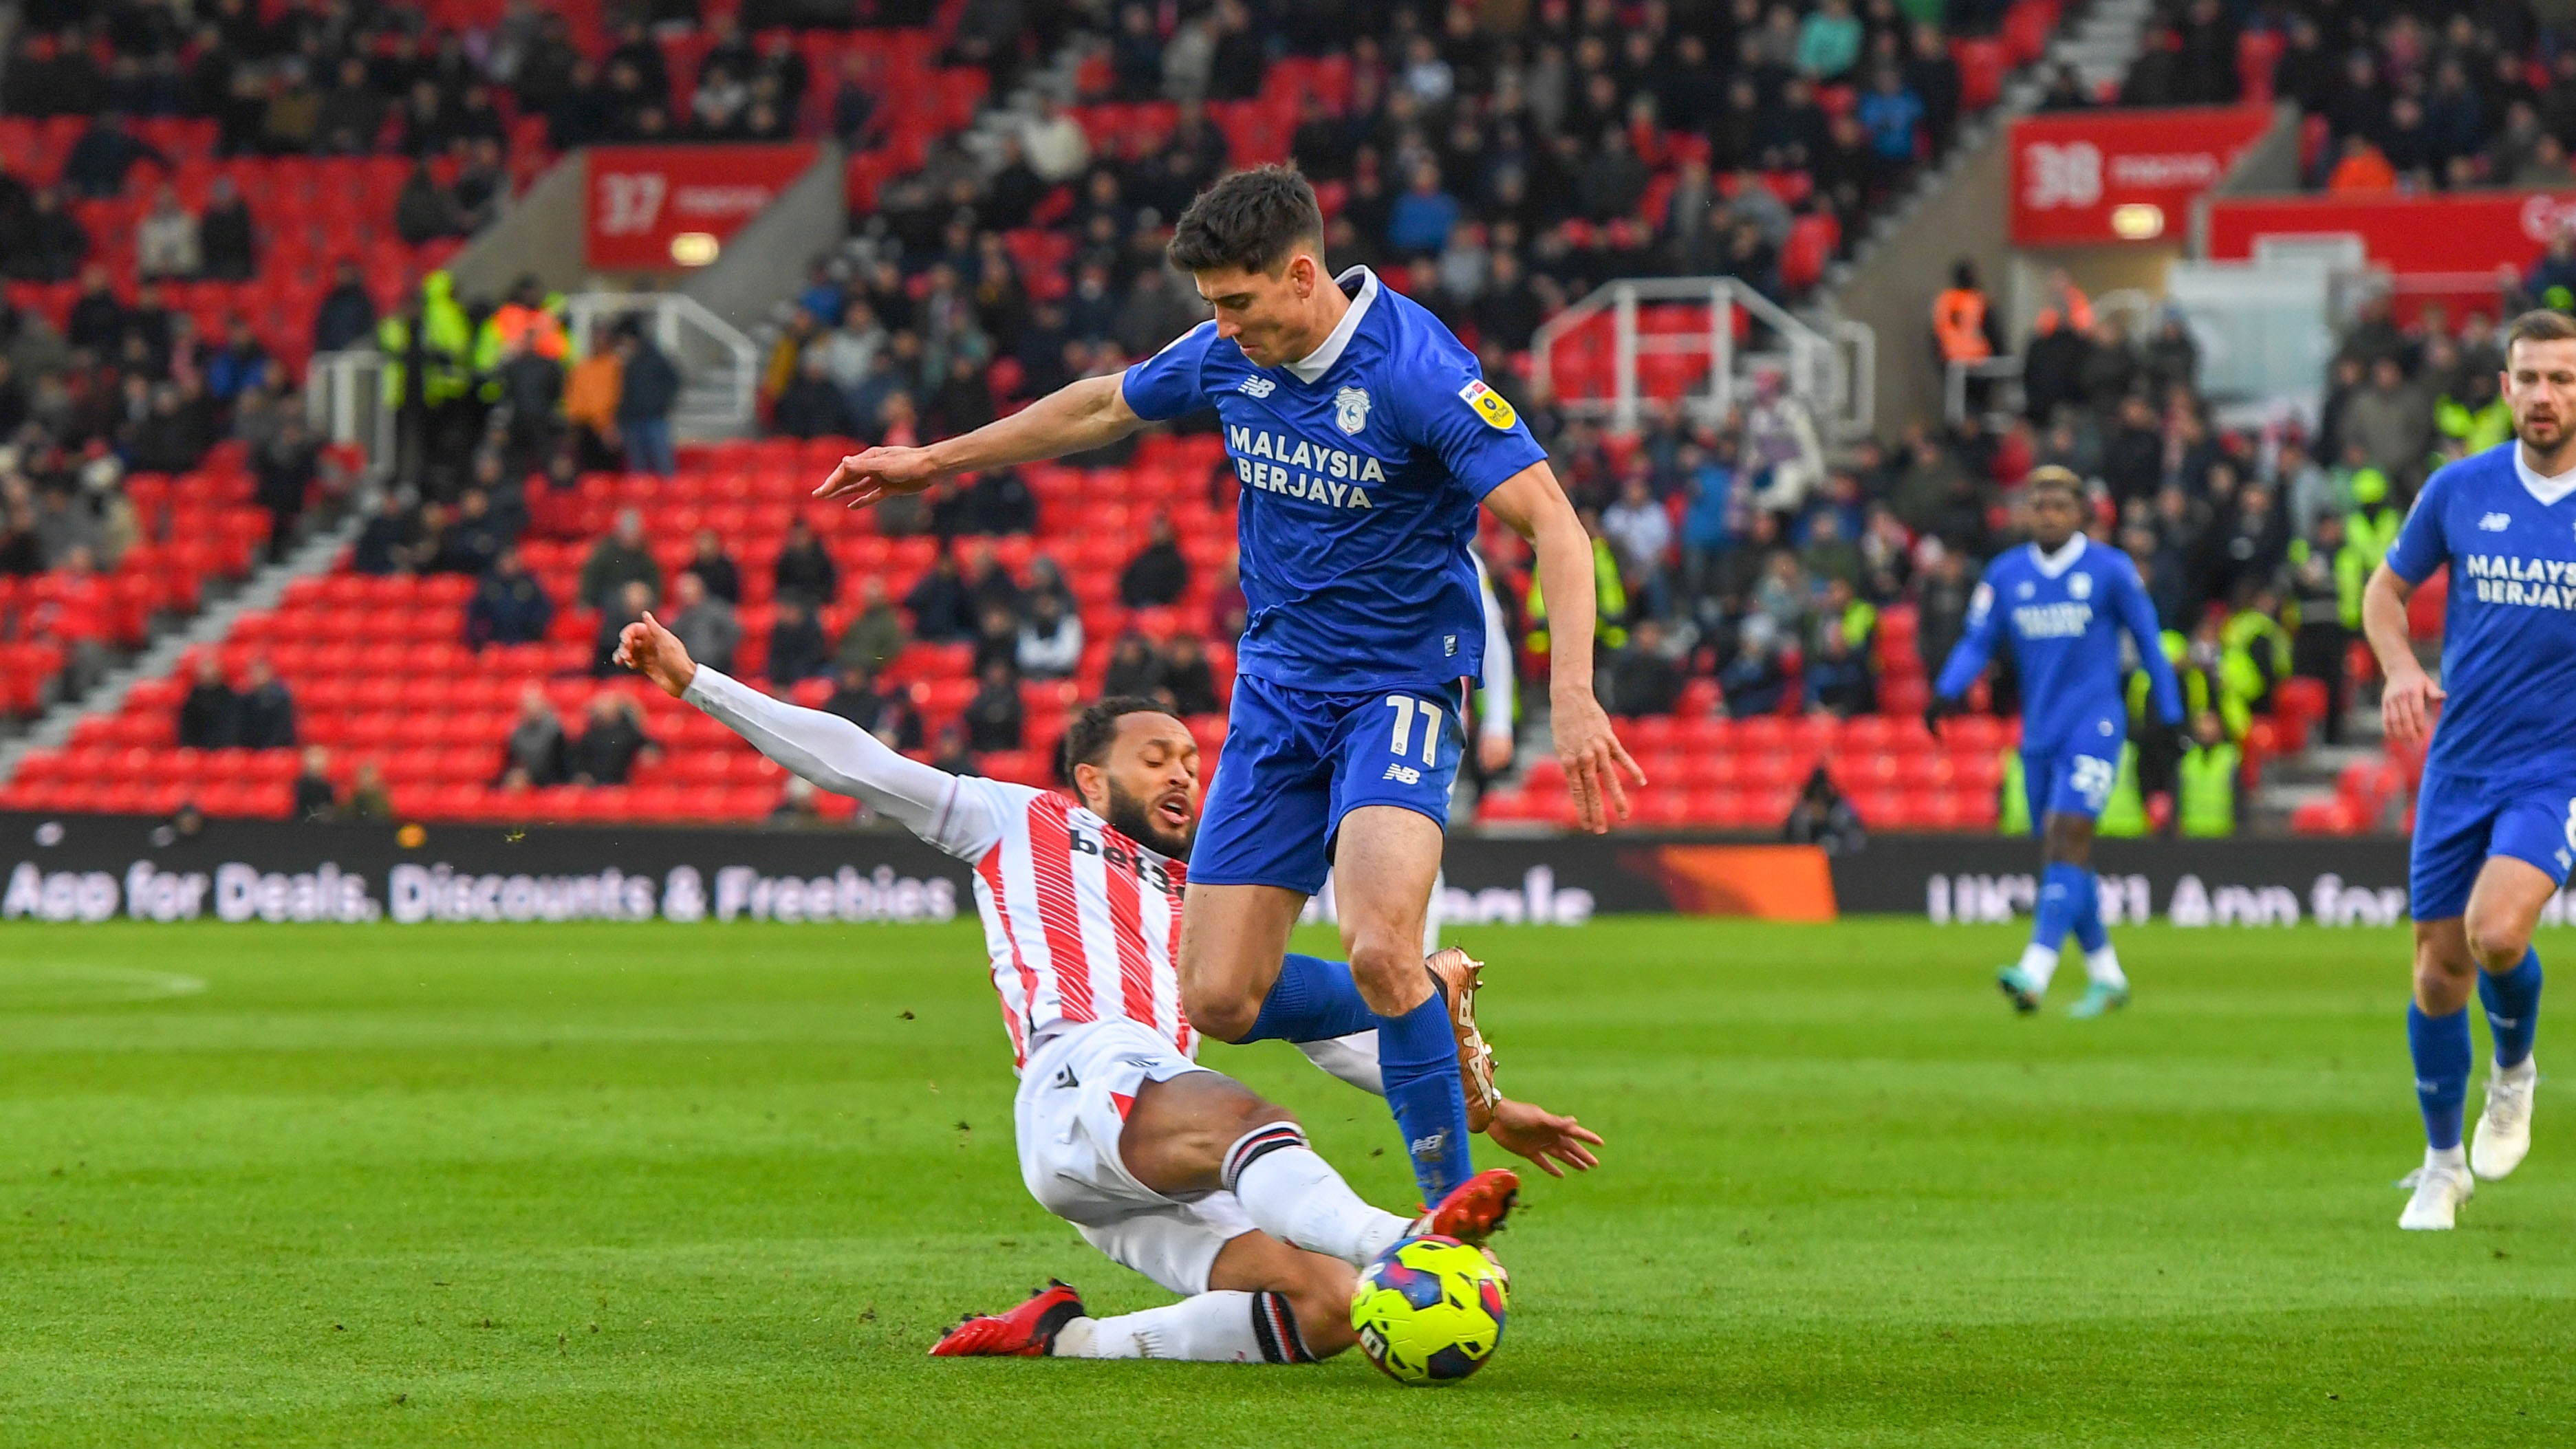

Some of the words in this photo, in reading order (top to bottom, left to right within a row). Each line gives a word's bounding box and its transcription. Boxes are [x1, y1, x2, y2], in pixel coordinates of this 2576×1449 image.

[600, 172, 667, 235] 37
[2025, 143, 2103, 208] 38
[1229, 424, 1385, 483] MALAYSIA
[1237, 457, 1372, 509] BERJAYA
[2476, 578, 2576, 611] BERJAY
[1386, 695, 1442, 768] 11
[126, 860, 209, 922] for
[389, 862, 655, 923] Discounts
[662, 864, 706, 923] &
[715, 864, 955, 924] Freebies
[1070, 829, 1185, 902] bet3
[2311, 872, 2406, 928] for
